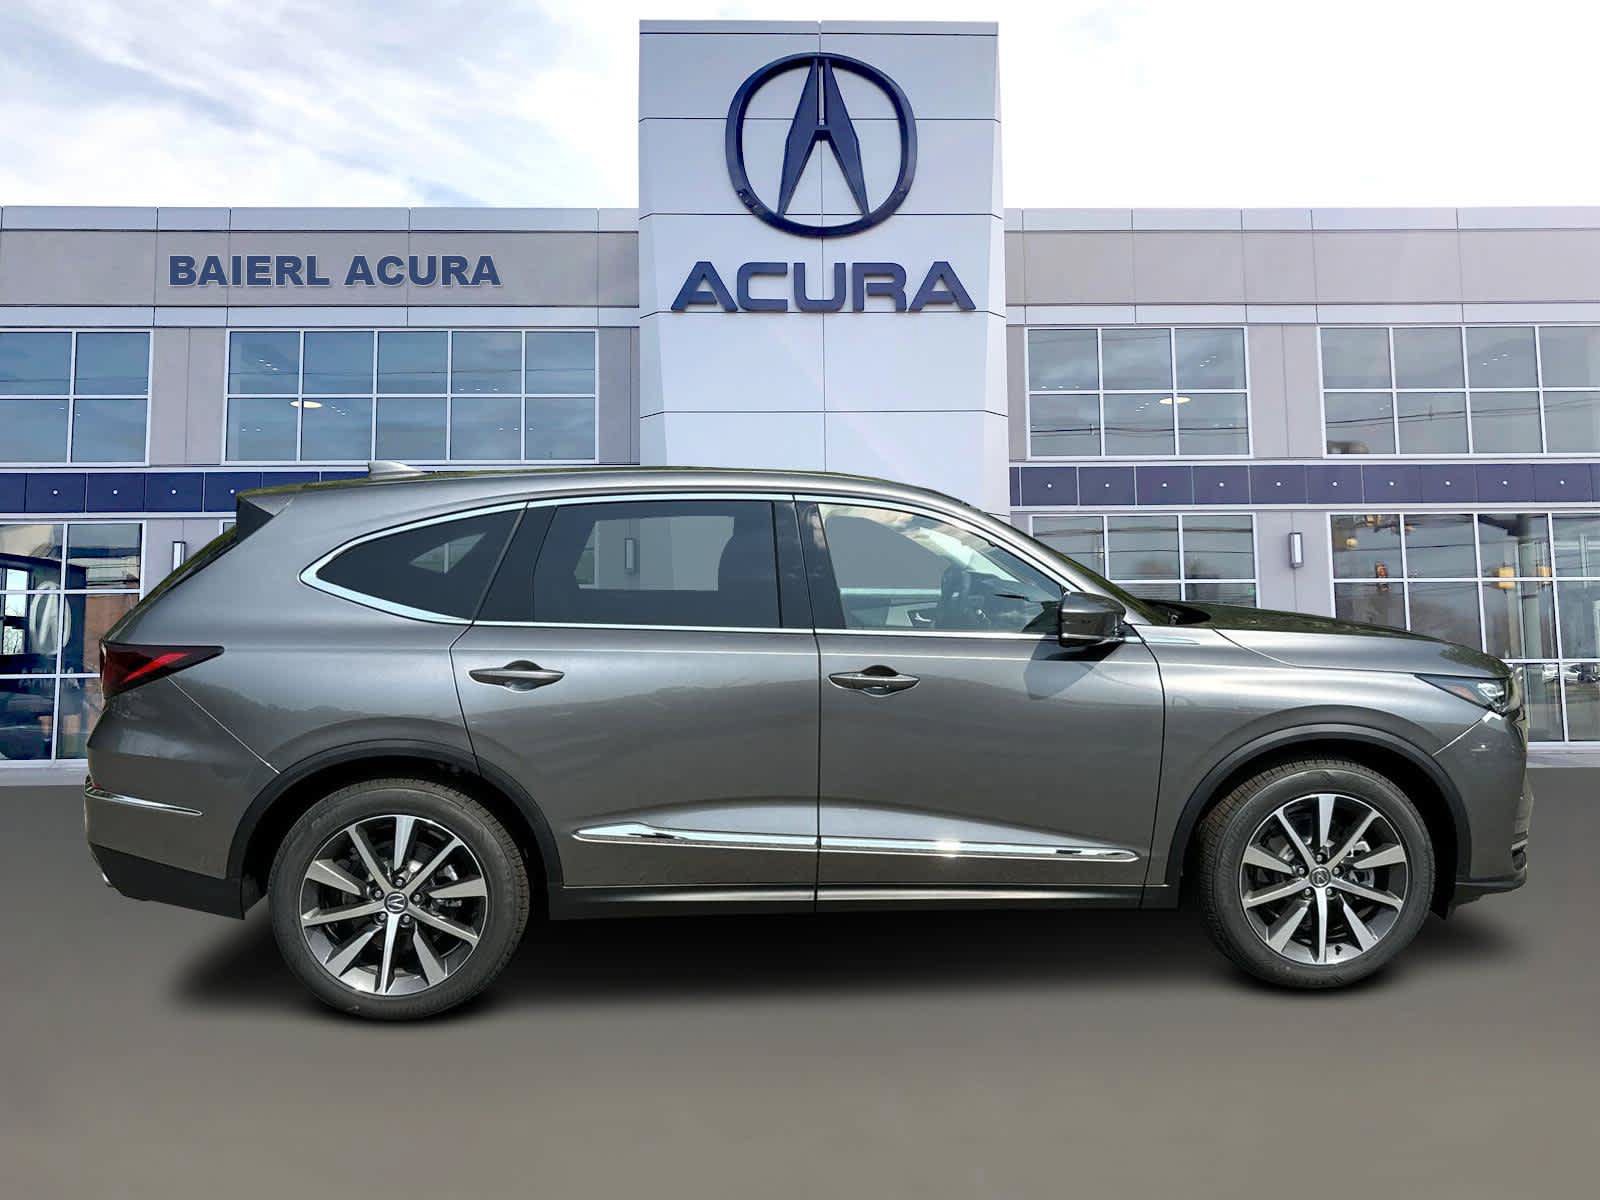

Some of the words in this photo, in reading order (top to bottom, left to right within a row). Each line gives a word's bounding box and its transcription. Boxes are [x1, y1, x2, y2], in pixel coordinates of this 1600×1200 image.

[169, 255, 330, 286] BAIERL
[345, 255, 501, 286] ACURA
[671, 261, 977, 312] ACURA
